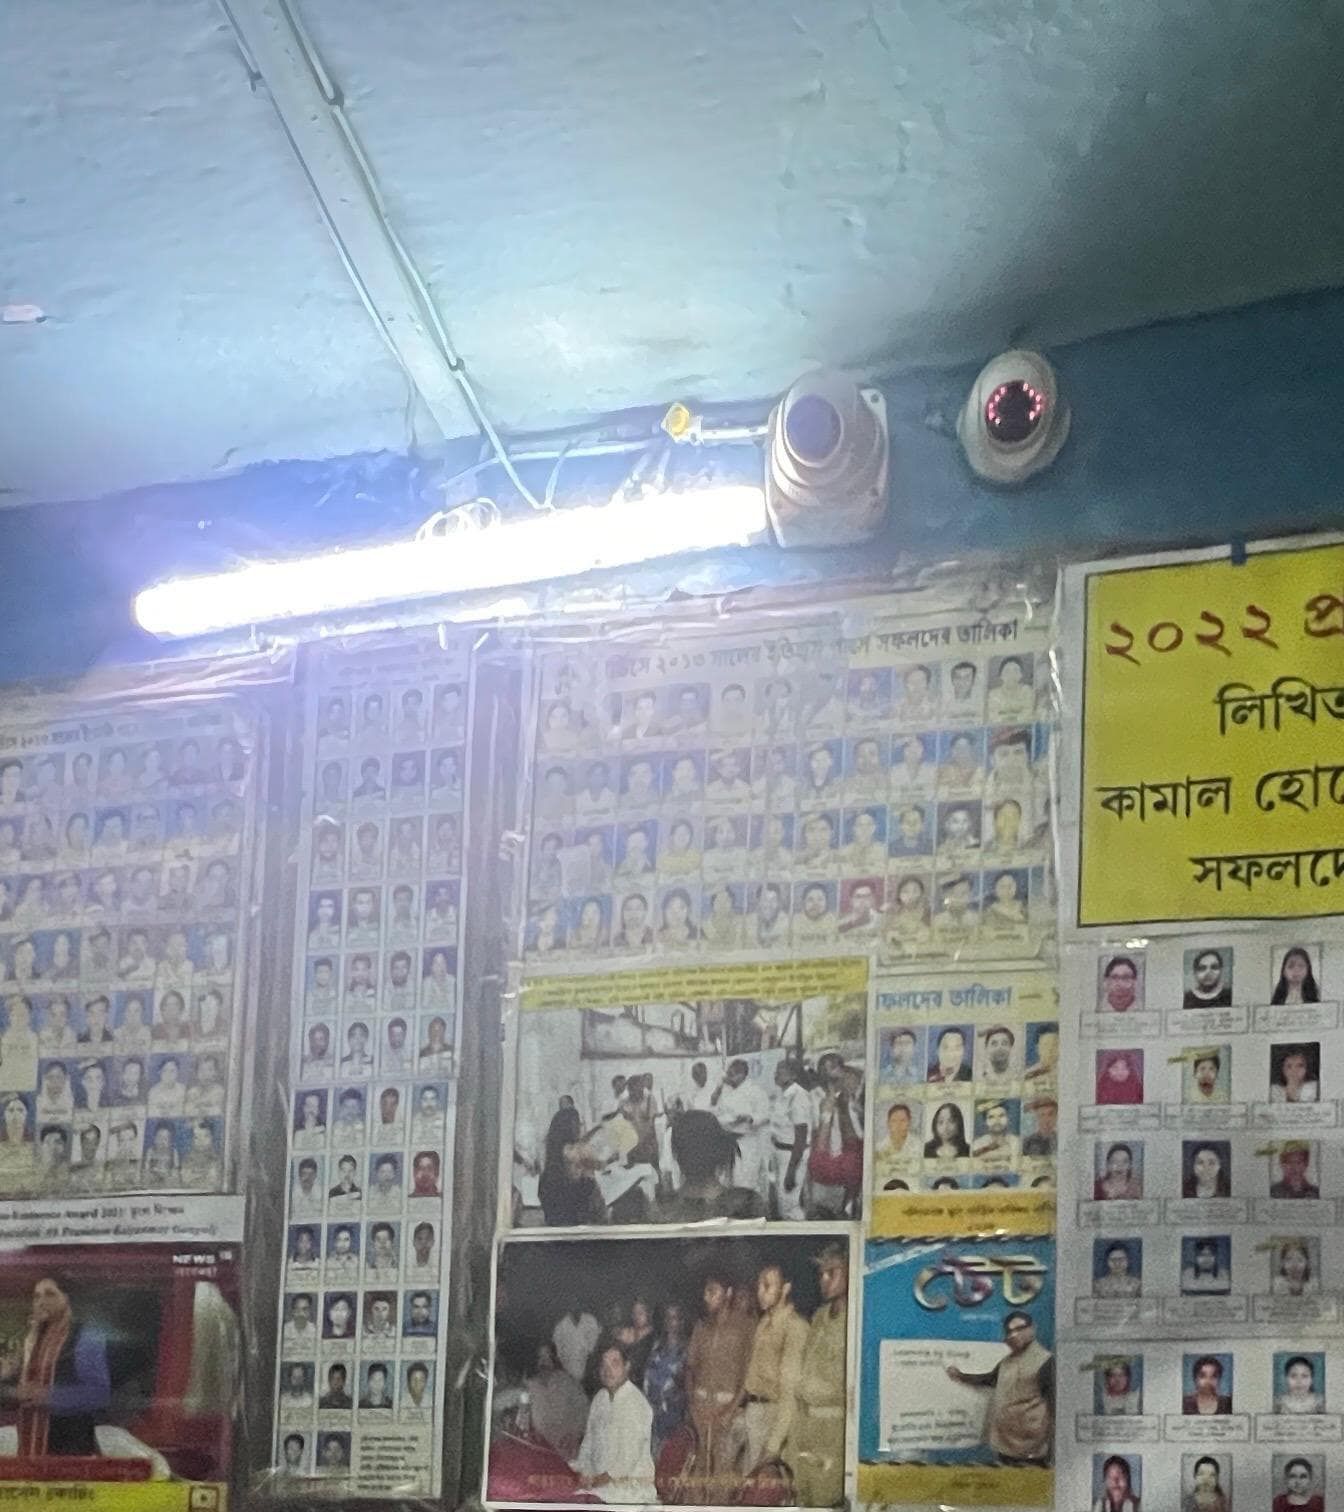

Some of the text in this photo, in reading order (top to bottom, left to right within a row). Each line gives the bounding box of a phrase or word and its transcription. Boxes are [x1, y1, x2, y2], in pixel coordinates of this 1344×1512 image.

[877, 631, 951, 652] সফলদের
[957, 619, 1020, 643] তালিকা
[1105, 604, 1278, 666] ২০২২
[1096, 776, 1231, 822] কামাল
[948, 983, 1012, 1009] তালিকা
[913, 1251, 1049, 1311] টেট
